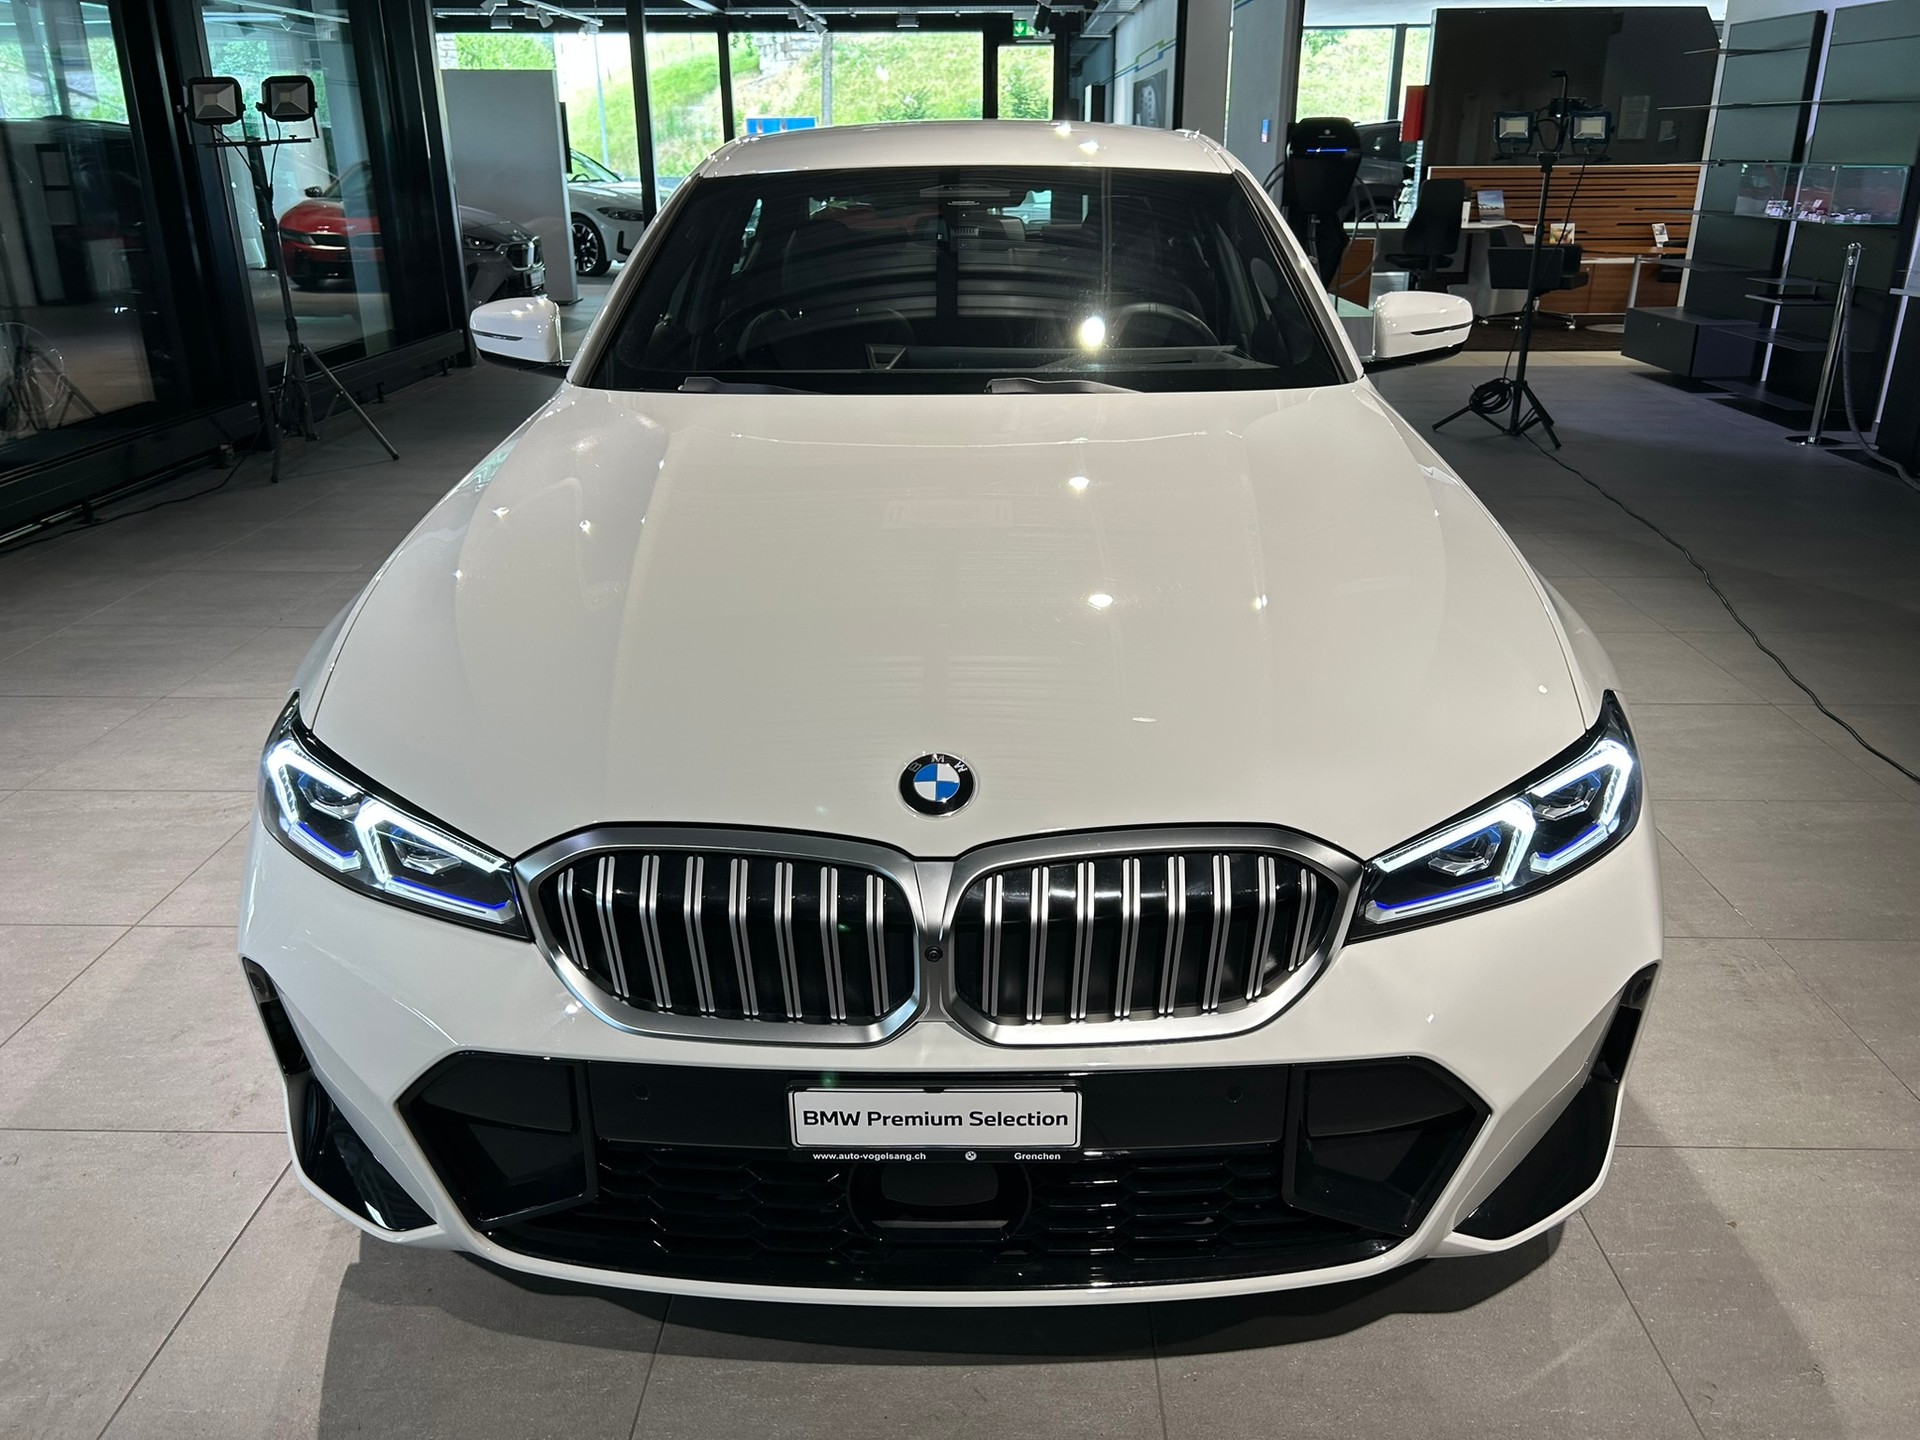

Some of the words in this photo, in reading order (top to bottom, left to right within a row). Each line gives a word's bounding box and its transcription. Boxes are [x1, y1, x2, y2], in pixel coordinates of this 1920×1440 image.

[907, 754, 969, 774] BMW
[802, 1110, 861, 1127] BMW
[867, 1110, 963, 1127] Premium
[968, 1110, 1069, 1127] Selection
[812, 1152, 927, 1162] www.auto-vogelsang.ch
[1013, 1152, 1061, 1160] Grenchen
